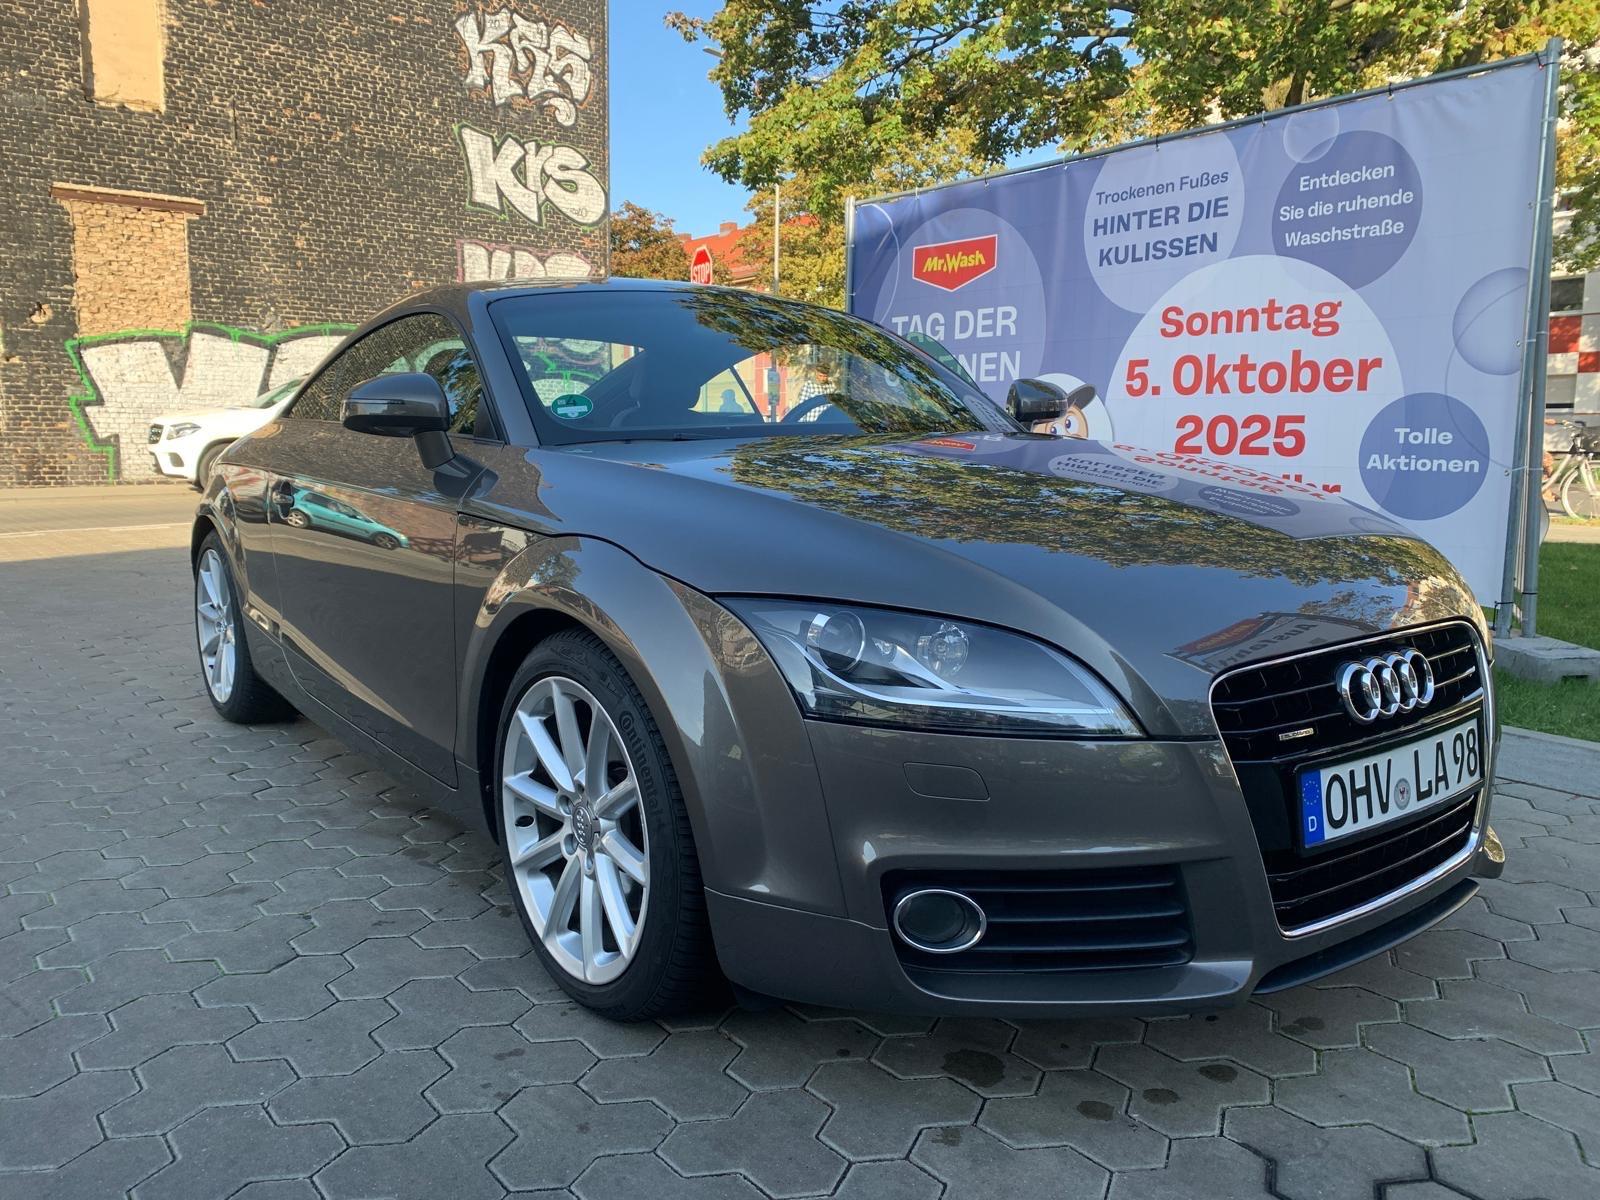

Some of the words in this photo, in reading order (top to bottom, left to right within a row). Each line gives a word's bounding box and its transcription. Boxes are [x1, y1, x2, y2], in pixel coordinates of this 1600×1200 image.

[1096, 181, 1175, 205] Trockenen
[1179, 171, 1229, 191] Fußes
[1299, 165, 1395, 192] Entdecken
[1093, 205, 1181, 237] HINTER
[1187, 196, 1229, 223] DIE
[1279, 205, 1305, 222] Sie
[1307, 200, 1334, 218] die
[1337, 188, 1414, 214] ruhende
[1098, 231, 1218, 268] KULISSEN
[1285, 219, 1405, 248] Waschstraße
[693, 262, 710, 284] STOP
[891, 312, 945, 343] TAG
[954, 306, 1018, 340] DER
[1160, 298, 1342, 338] Sonntag
[1125, 358, 1161, 397] 5.
[1172, 350, 1383, 397] Oktober
[1174, 414, 1306, 457] 2025
[1394, 427, 1454, 445] Tolle
[1366, 454, 1480, 473] Aktionen
[1325, 758, 1392, 829] OHV
[1413, 740, 1449, 802] LA
[1452, 727, 1478, 784] 98
[1308, 815, 1317, 832] D
